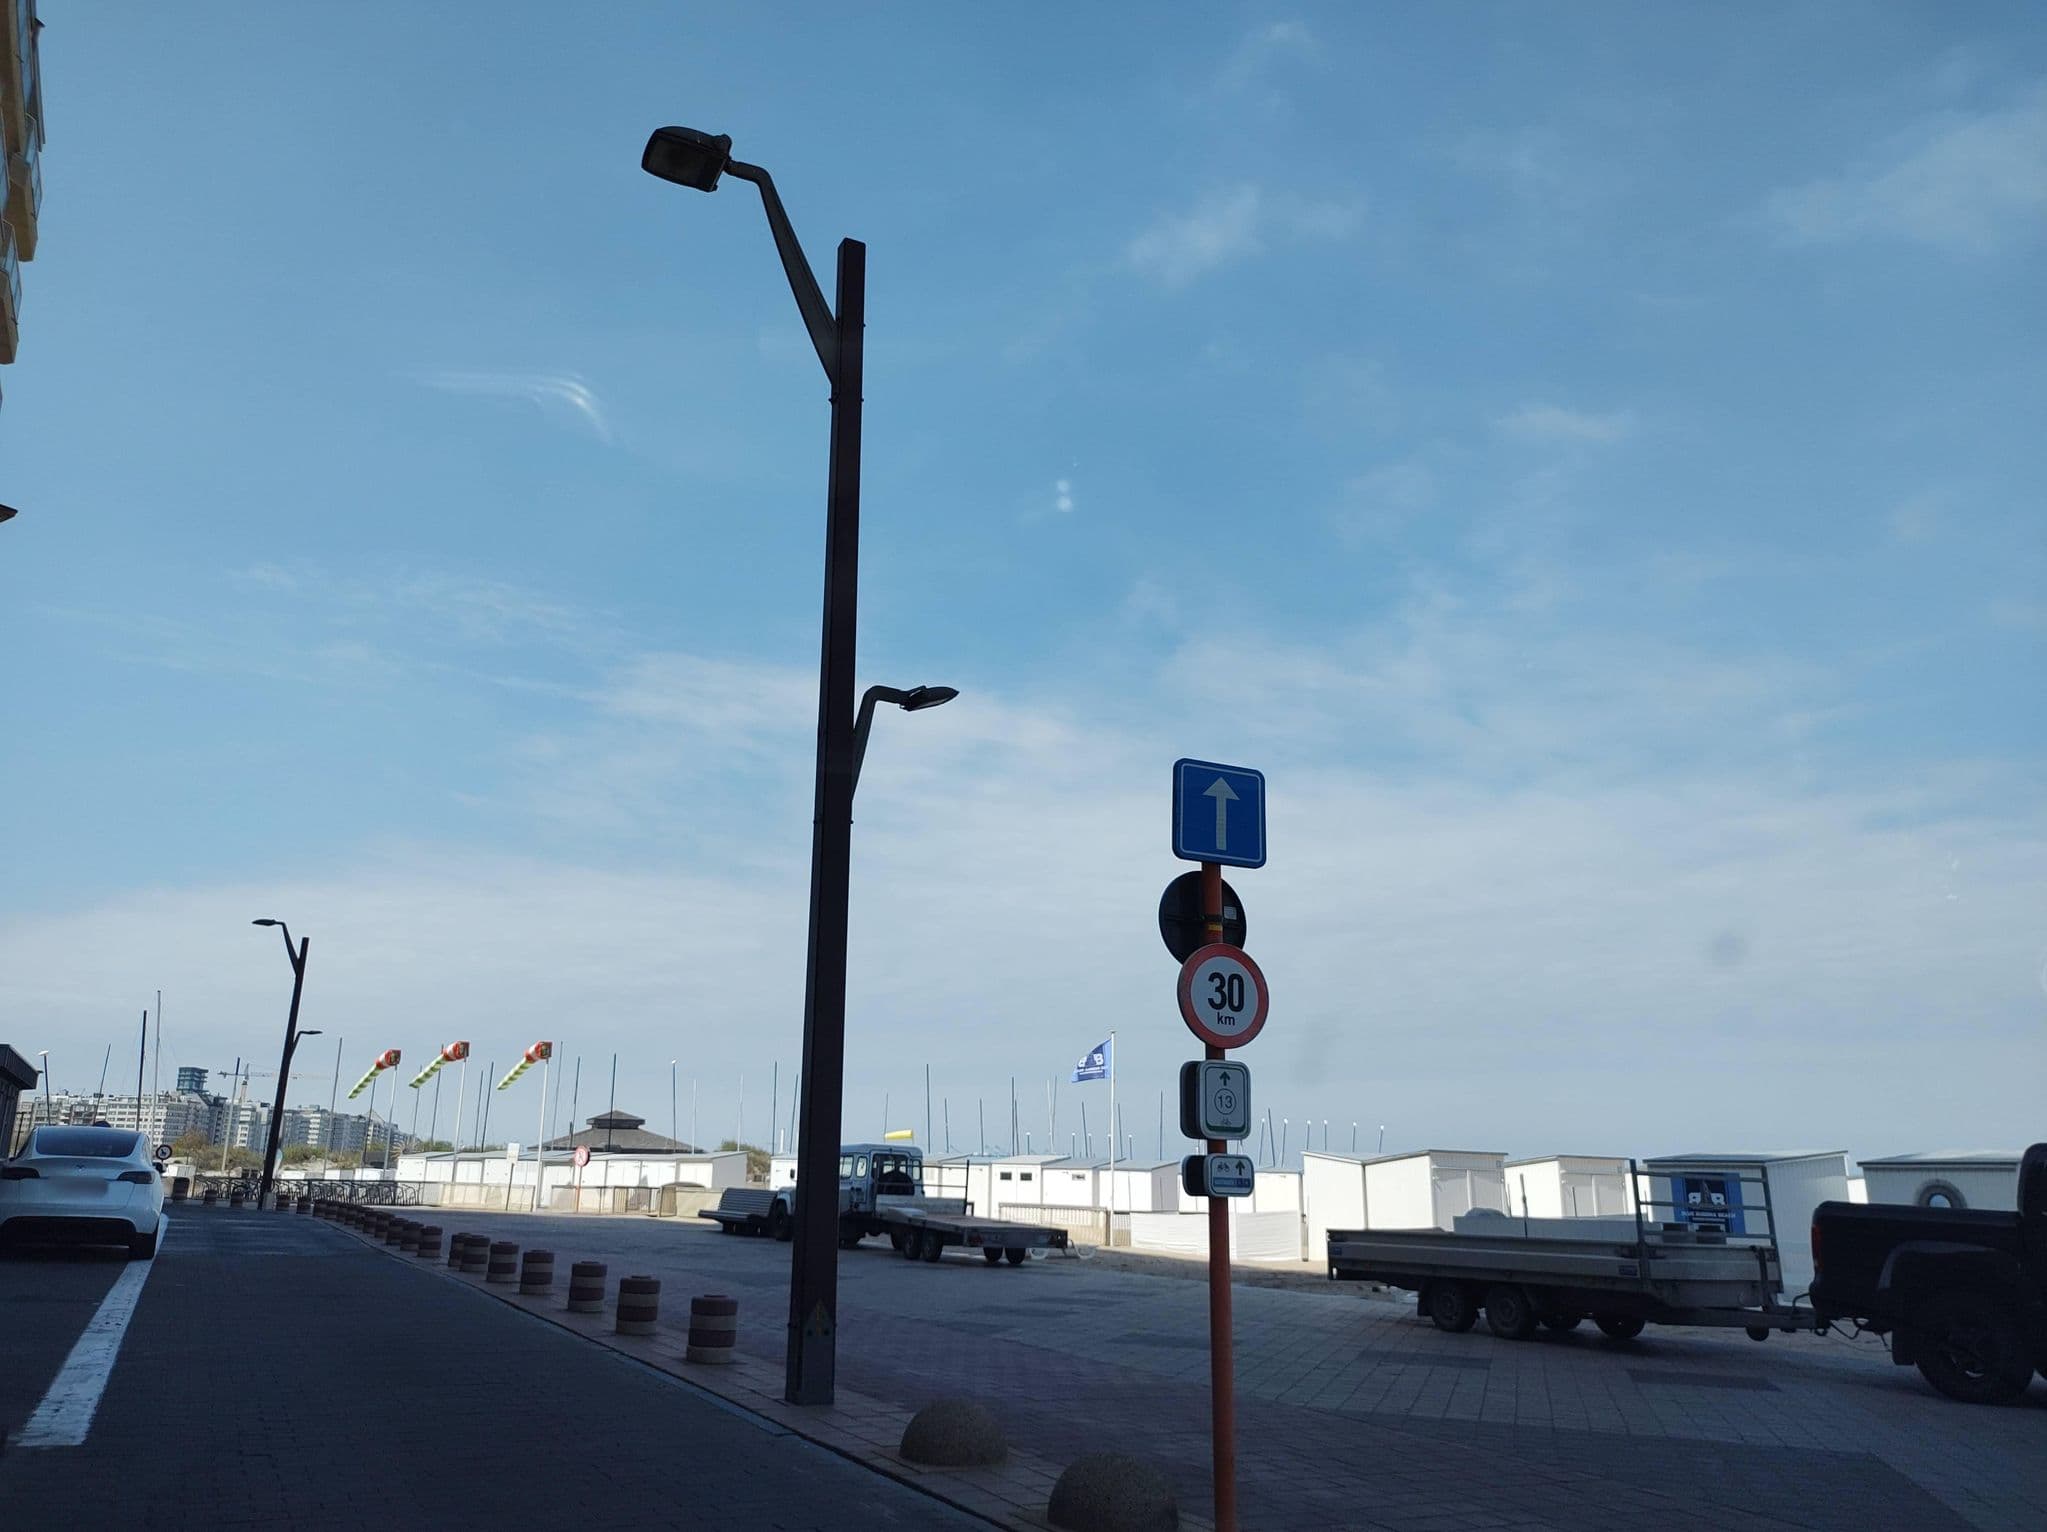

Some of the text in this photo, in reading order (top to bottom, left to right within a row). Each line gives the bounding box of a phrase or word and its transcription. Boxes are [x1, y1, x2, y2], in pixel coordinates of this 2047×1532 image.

[1208, 972, 1244, 1012] 30
[1217, 1012, 1235, 1026] km
[1218, 1095, 1233, 1109] 13
